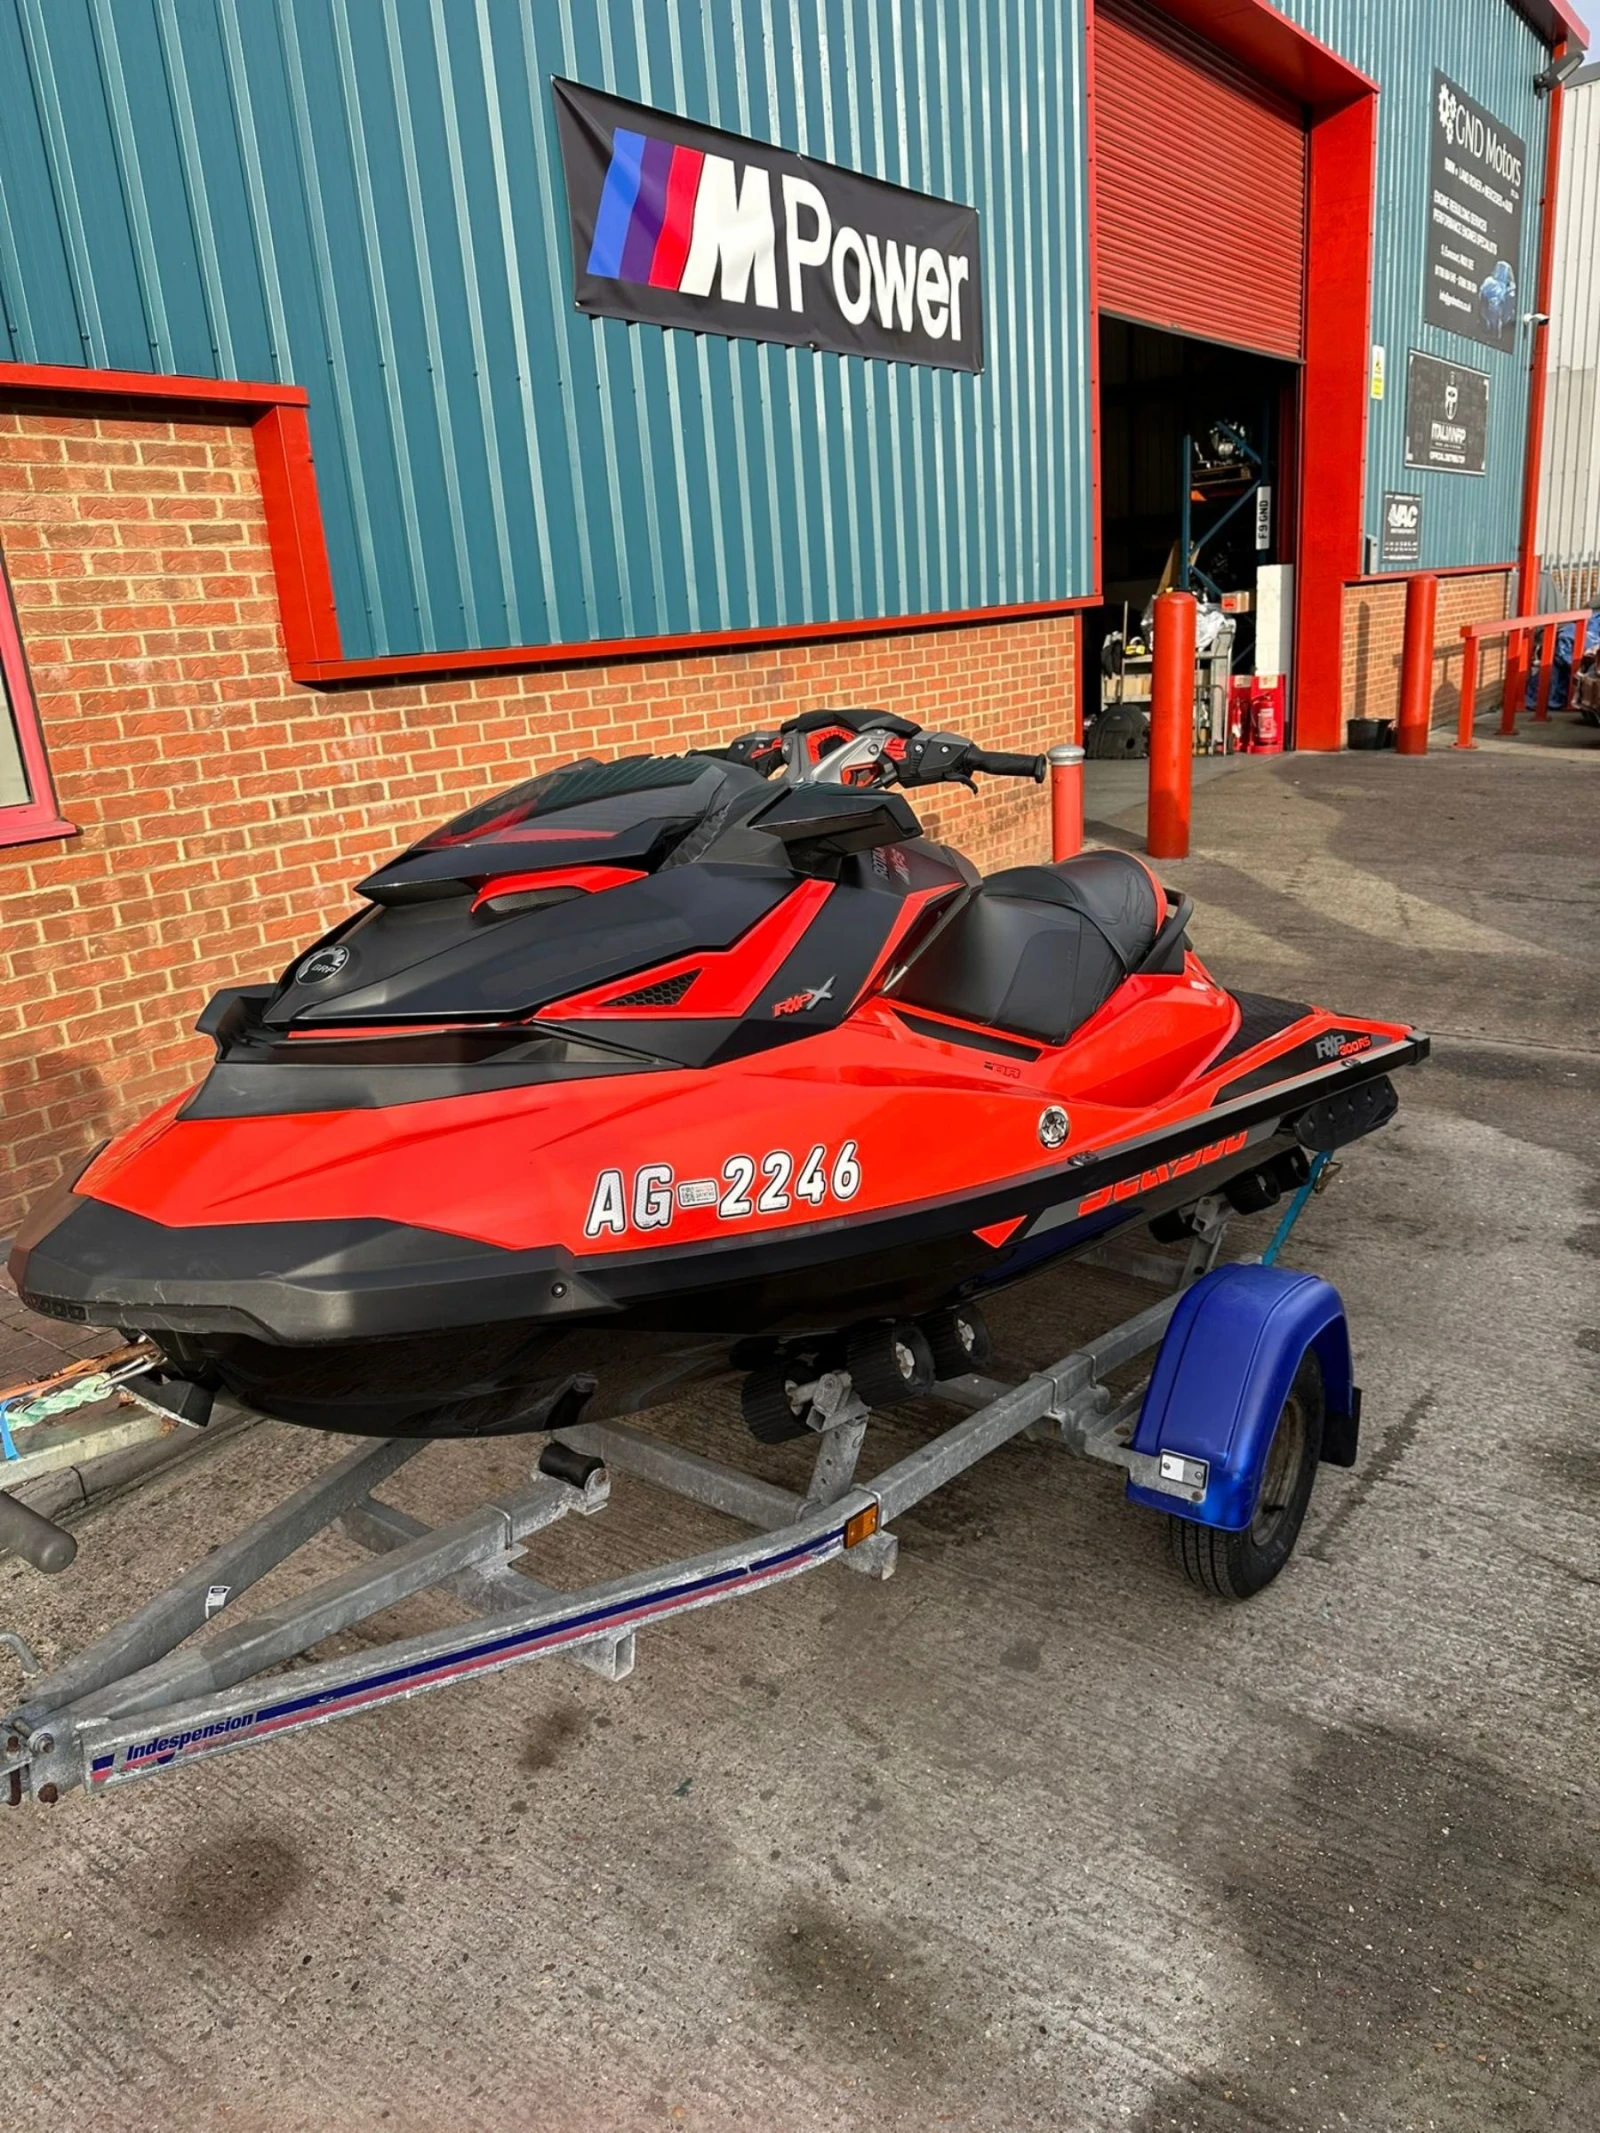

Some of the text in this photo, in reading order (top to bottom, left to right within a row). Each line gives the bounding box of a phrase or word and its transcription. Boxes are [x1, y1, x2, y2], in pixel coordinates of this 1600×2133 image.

[1455, 104, 1521, 188] GND Motors
[1259, 500, 1269, 522] GND
[311, 963, 336, 973] BRP
[584, 1141, 860, 1236] AG 2246
[127, 1713, 254, 1761] Indespension
